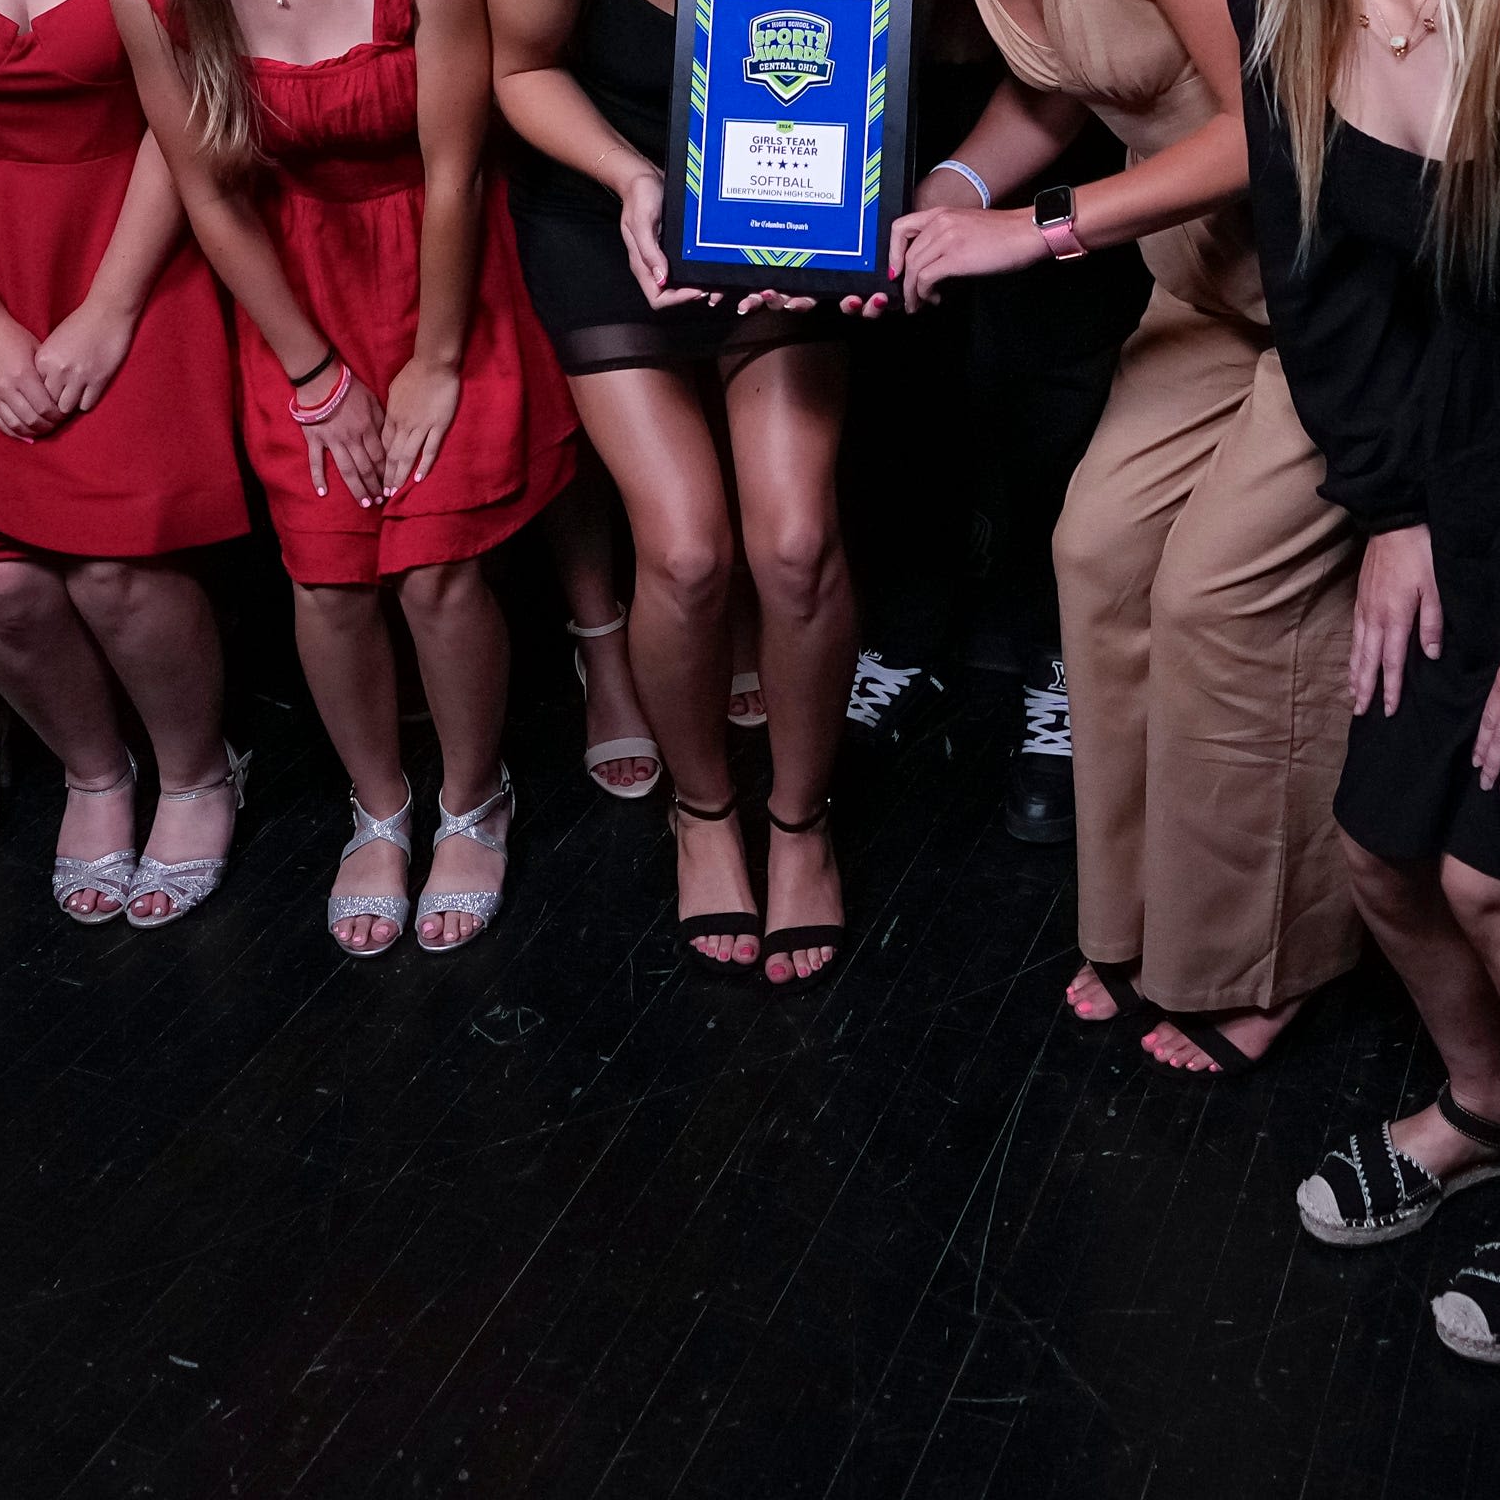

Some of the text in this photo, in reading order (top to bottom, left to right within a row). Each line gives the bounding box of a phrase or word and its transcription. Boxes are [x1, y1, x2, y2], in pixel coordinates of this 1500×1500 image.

[788, 21, 810, 29] SCHOOL
[754, 28, 827, 50] SPORTS
[752, 45, 826, 65] AWARDS
[759, 62, 818, 73] CENTRAL OHIO
[752, 135, 816, 146] GIRLS TEAM
[749, 144, 818, 156] OF THE YEAR
[749, 175, 813, 188] SOFTBALL
[726, 187, 836, 199] LIBERTY UNION HIGH SCHOOL
